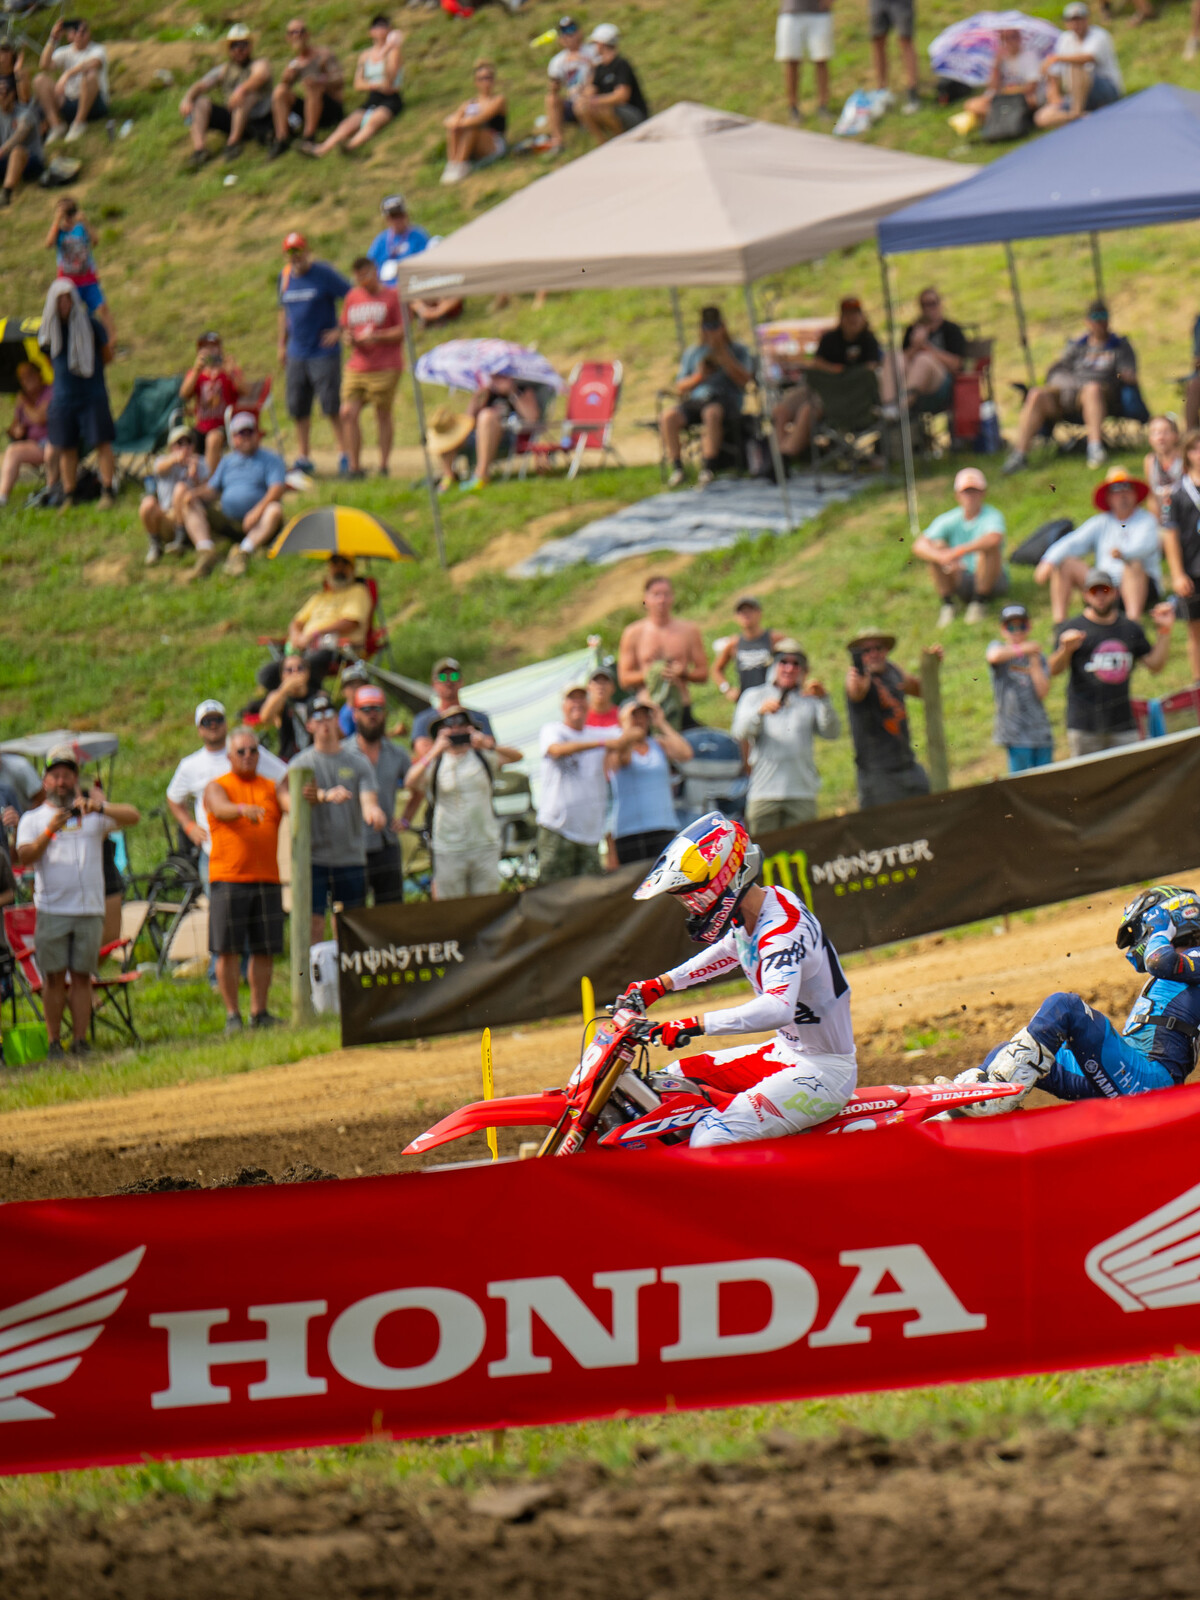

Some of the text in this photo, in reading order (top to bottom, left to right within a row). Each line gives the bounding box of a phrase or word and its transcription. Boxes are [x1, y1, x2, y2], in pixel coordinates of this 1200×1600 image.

[688, 955, 738, 980] HONDA
[931, 1089, 993, 1102] DUNLOP
[839, 1099, 898, 1116] HONDA
[150, 1244, 986, 1409] HONDA
